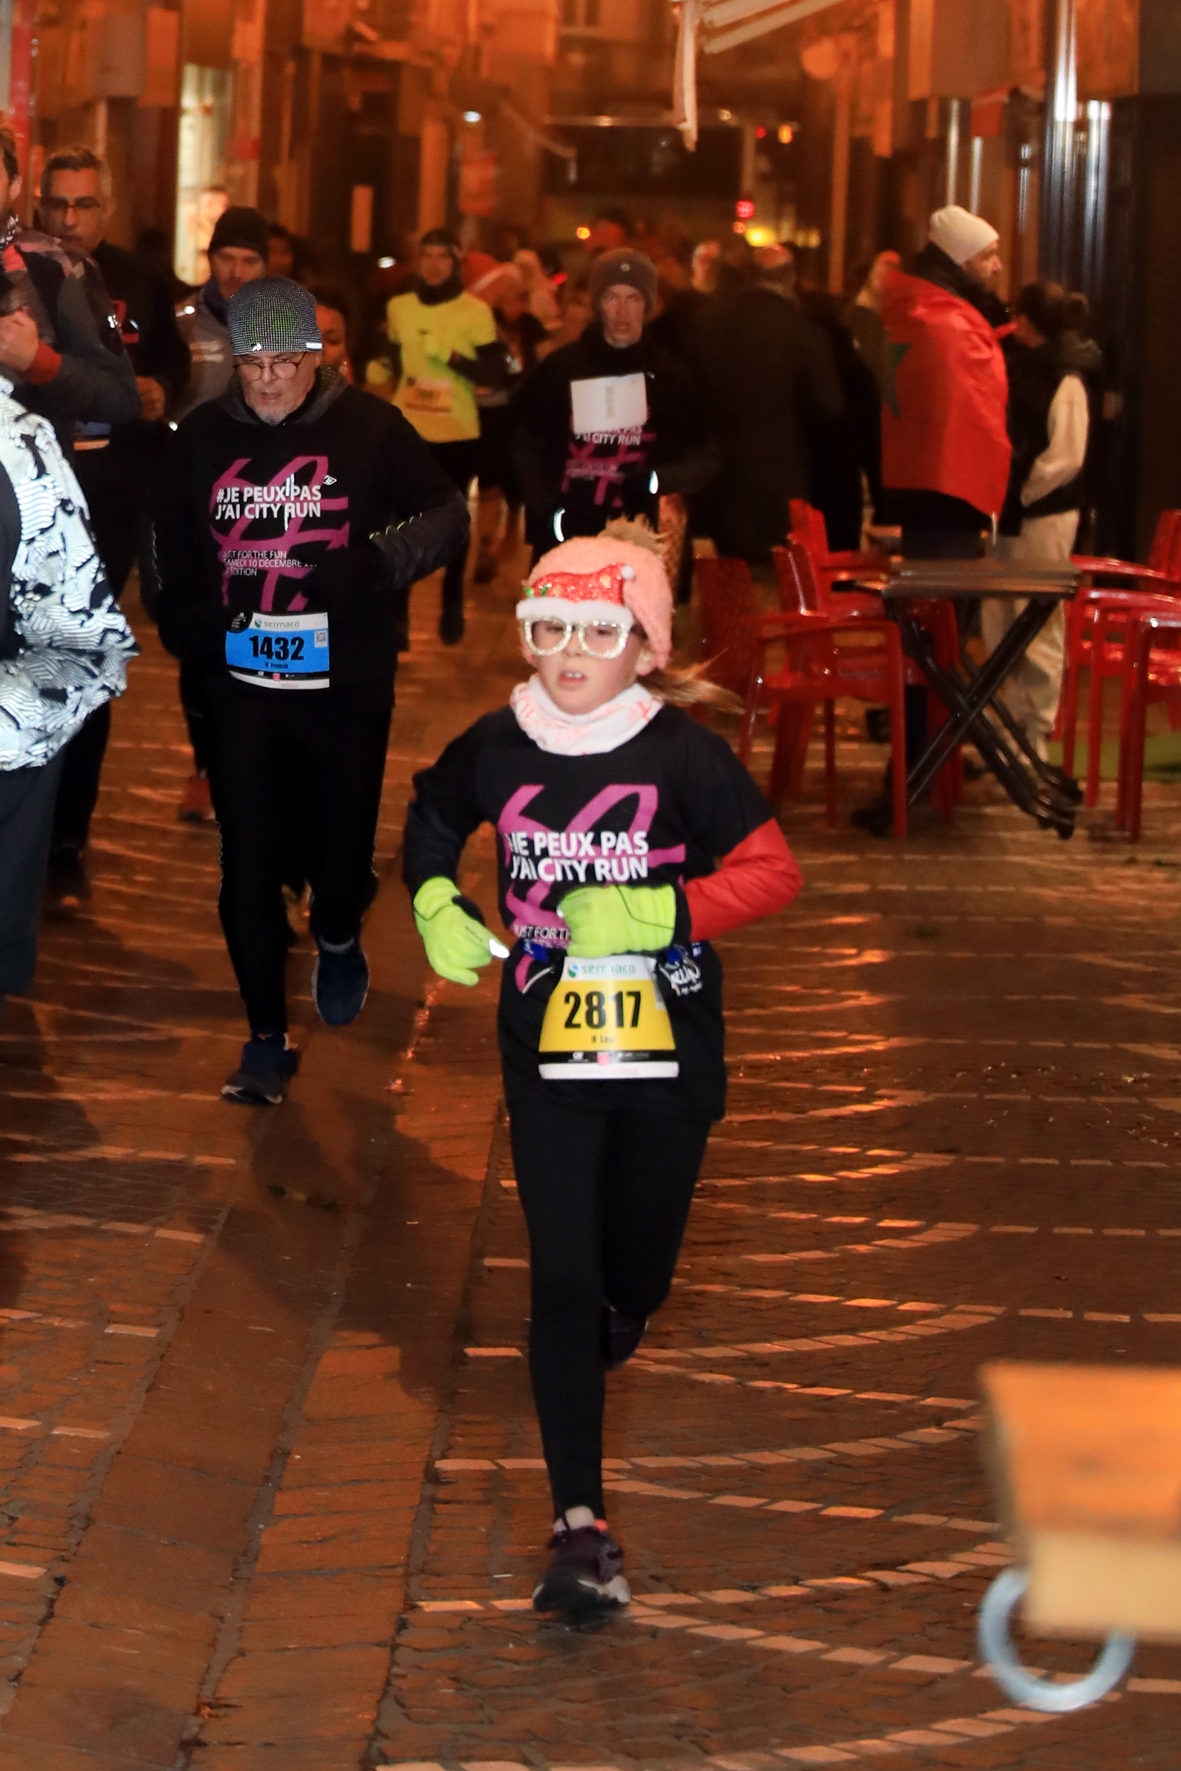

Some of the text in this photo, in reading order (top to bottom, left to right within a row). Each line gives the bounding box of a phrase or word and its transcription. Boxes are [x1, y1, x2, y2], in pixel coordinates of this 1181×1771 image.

[216, 485, 322, 503] #JE PEUX PAS
[215, 502, 321, 520] J'AI CITY RUN
[237, 551, 252, 559] FOR
[254, 551, 268, 559] THE
[270, 550, 287, 559] FUN
[249, 559, 257, 567] 10
[264, 620, 300, 628] sermaco
[249, 635, 304, 660] 1432
[533, 832, 595, 856] PEUX
[600, 831, 649, 856] PAS
[537, 859, 588, 882] CITY
[594, 856, 648, 881] RUN
[534, 927, 558, 939] FOR
[564, 990, 642, 1029] 2817
